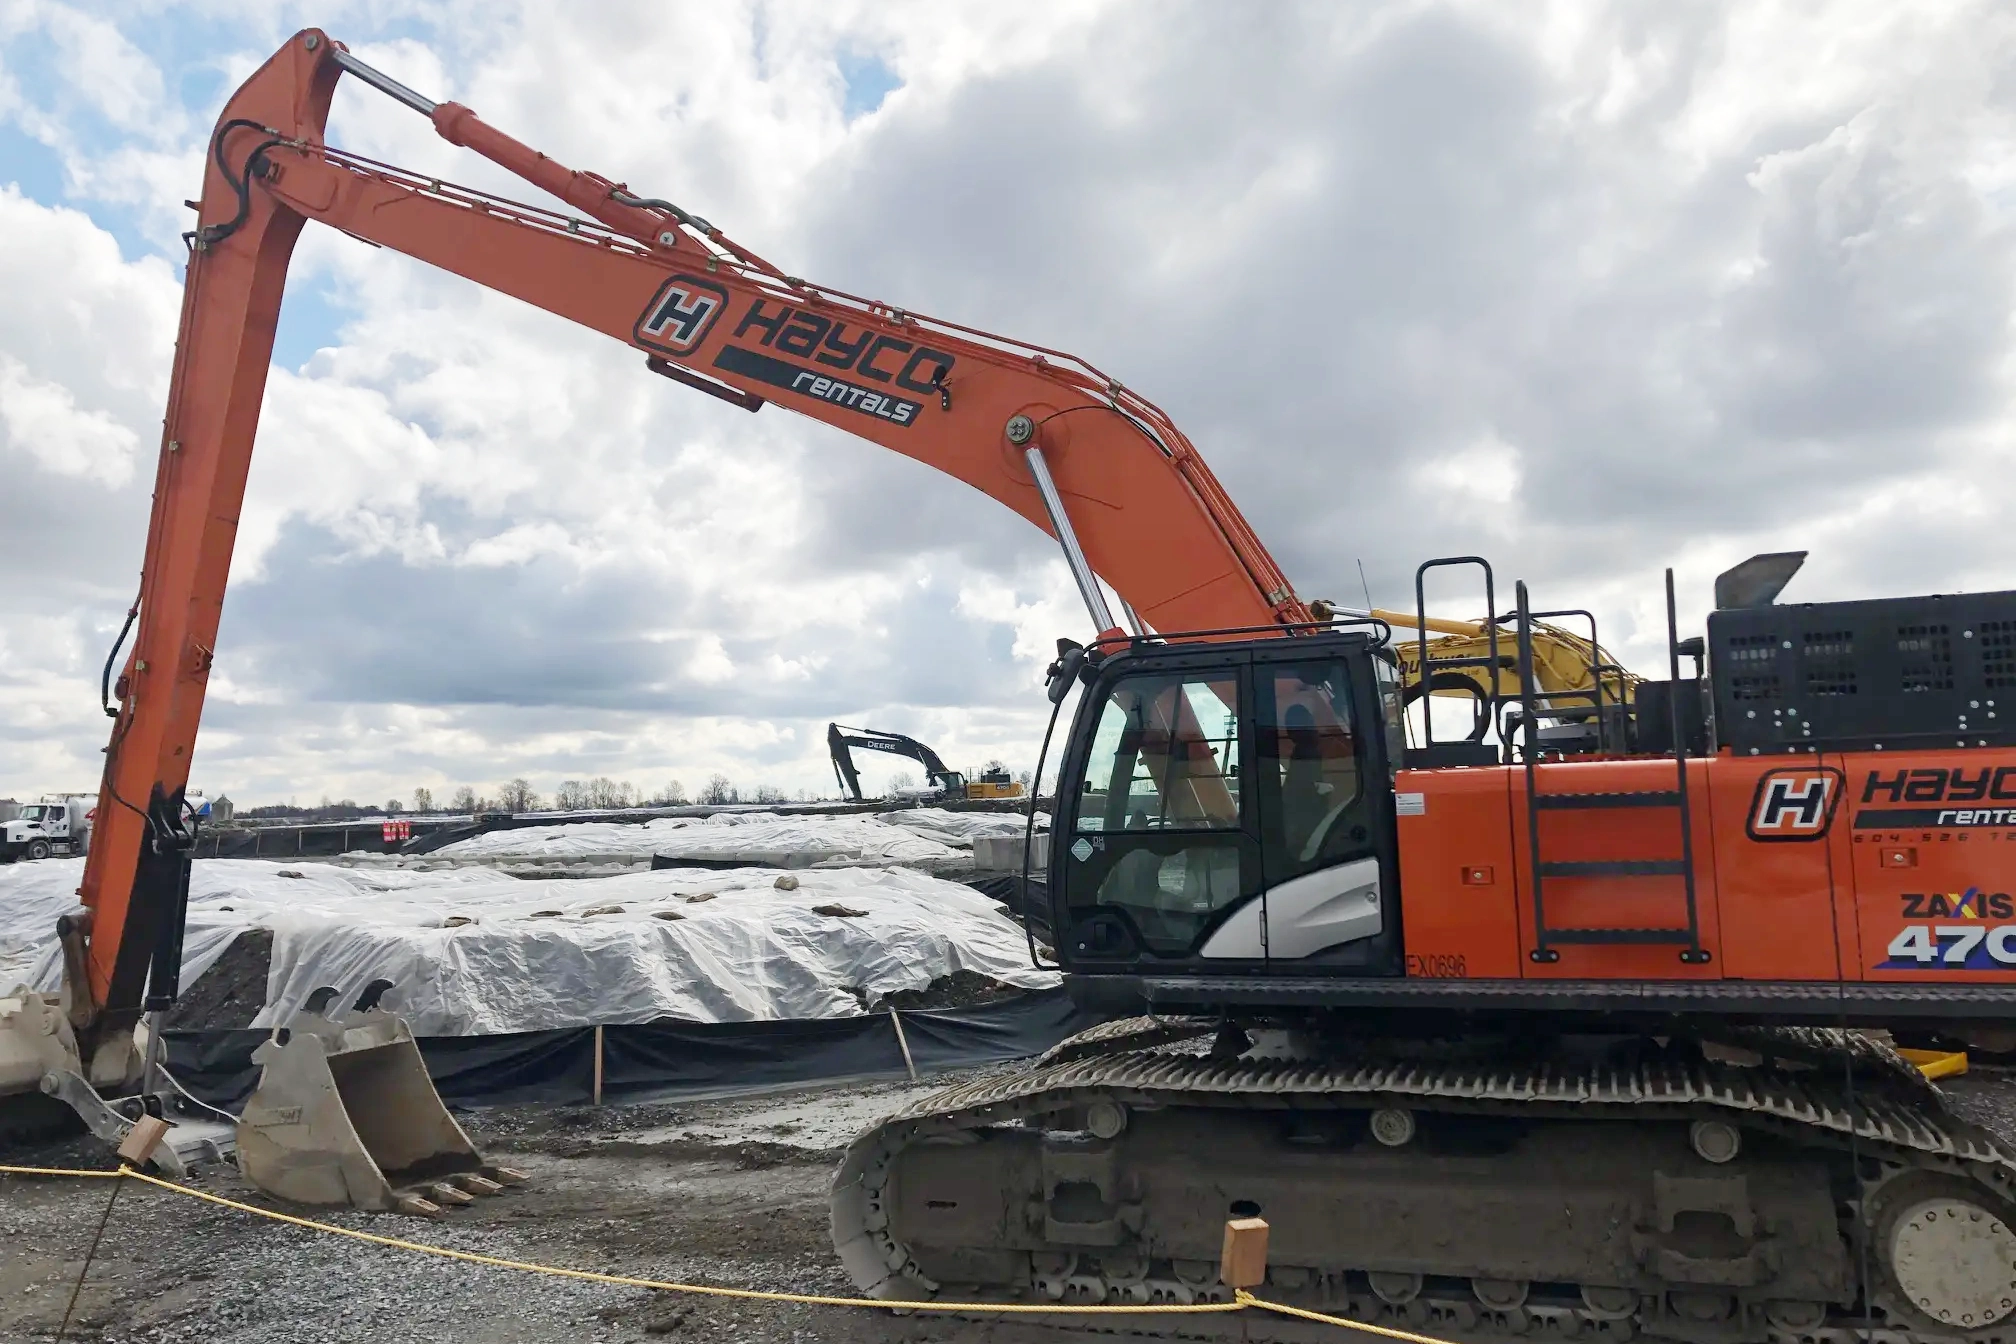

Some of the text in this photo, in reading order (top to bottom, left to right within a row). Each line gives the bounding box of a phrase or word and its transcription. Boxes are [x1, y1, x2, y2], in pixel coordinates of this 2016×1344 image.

[641, 286, 718, 346] H
[791, 371, 914, 423] rentals
[867, 740, 896, 750] DEERE
[1756, 777, 1833, 829] H
[1900, 886, 2016, 920] ZAXIS
[1406, 954, 1467, 977] EX0696
